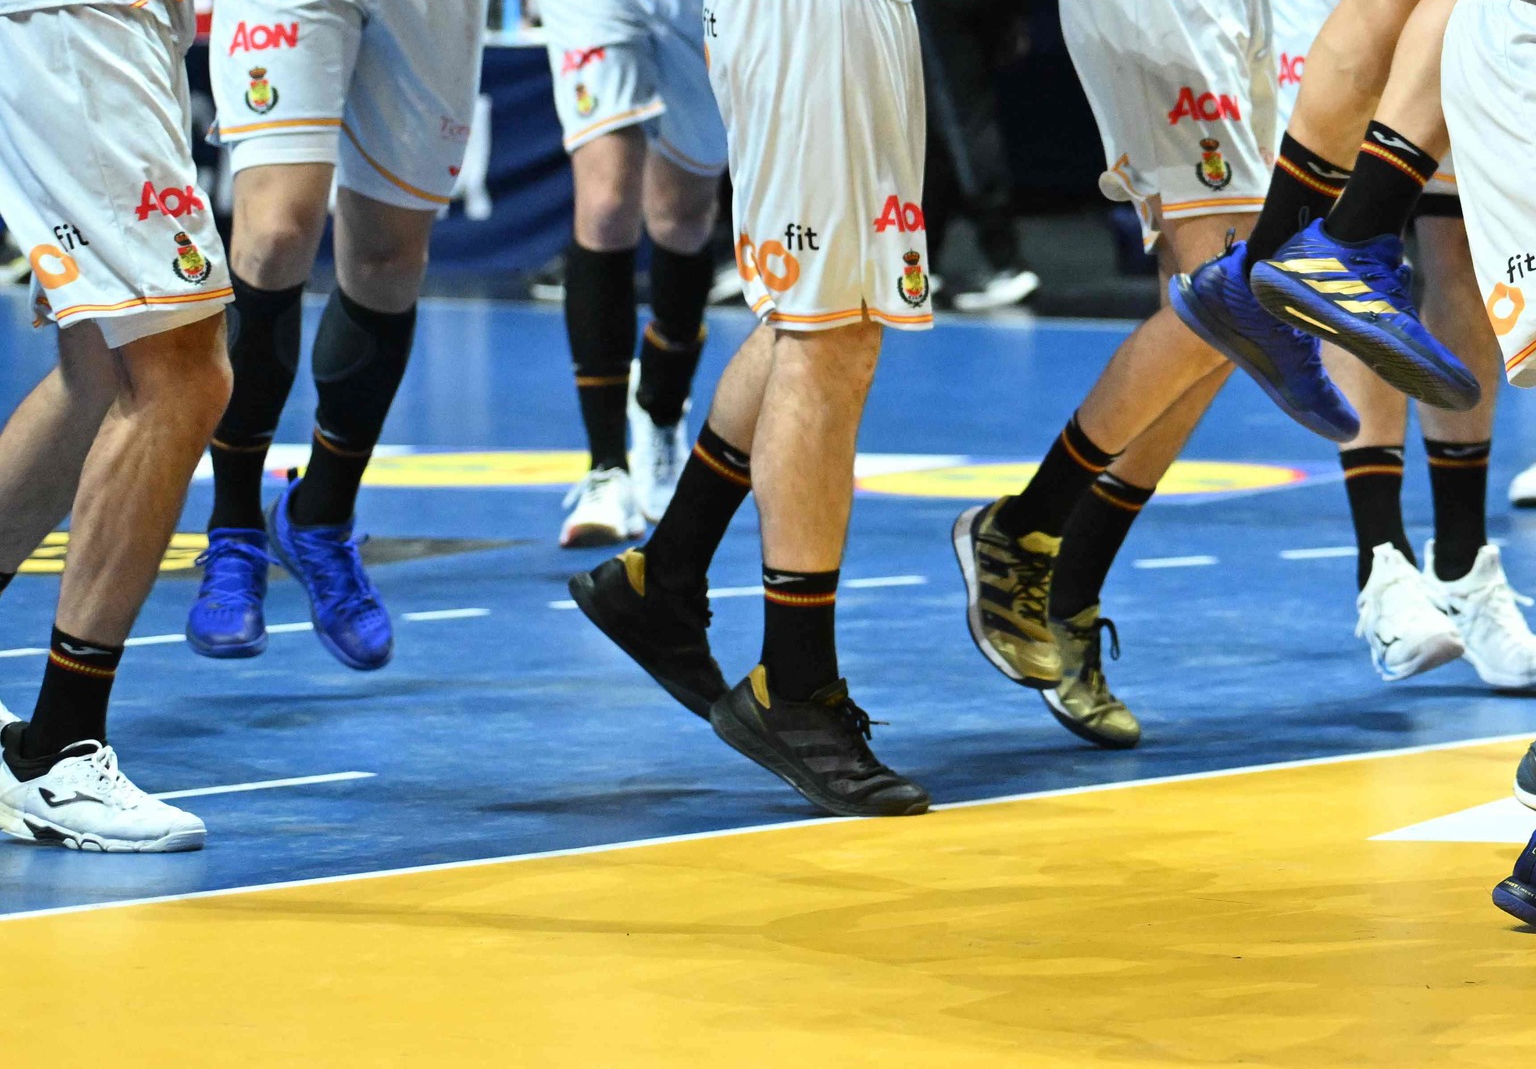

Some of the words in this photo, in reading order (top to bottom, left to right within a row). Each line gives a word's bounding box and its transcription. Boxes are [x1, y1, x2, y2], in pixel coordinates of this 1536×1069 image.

[229, 21, 299, 56] AON
[1168, 86, 1241, 126] AON
[53, 224, 90, 252] fit
[785, 224, 820, 251] fit
